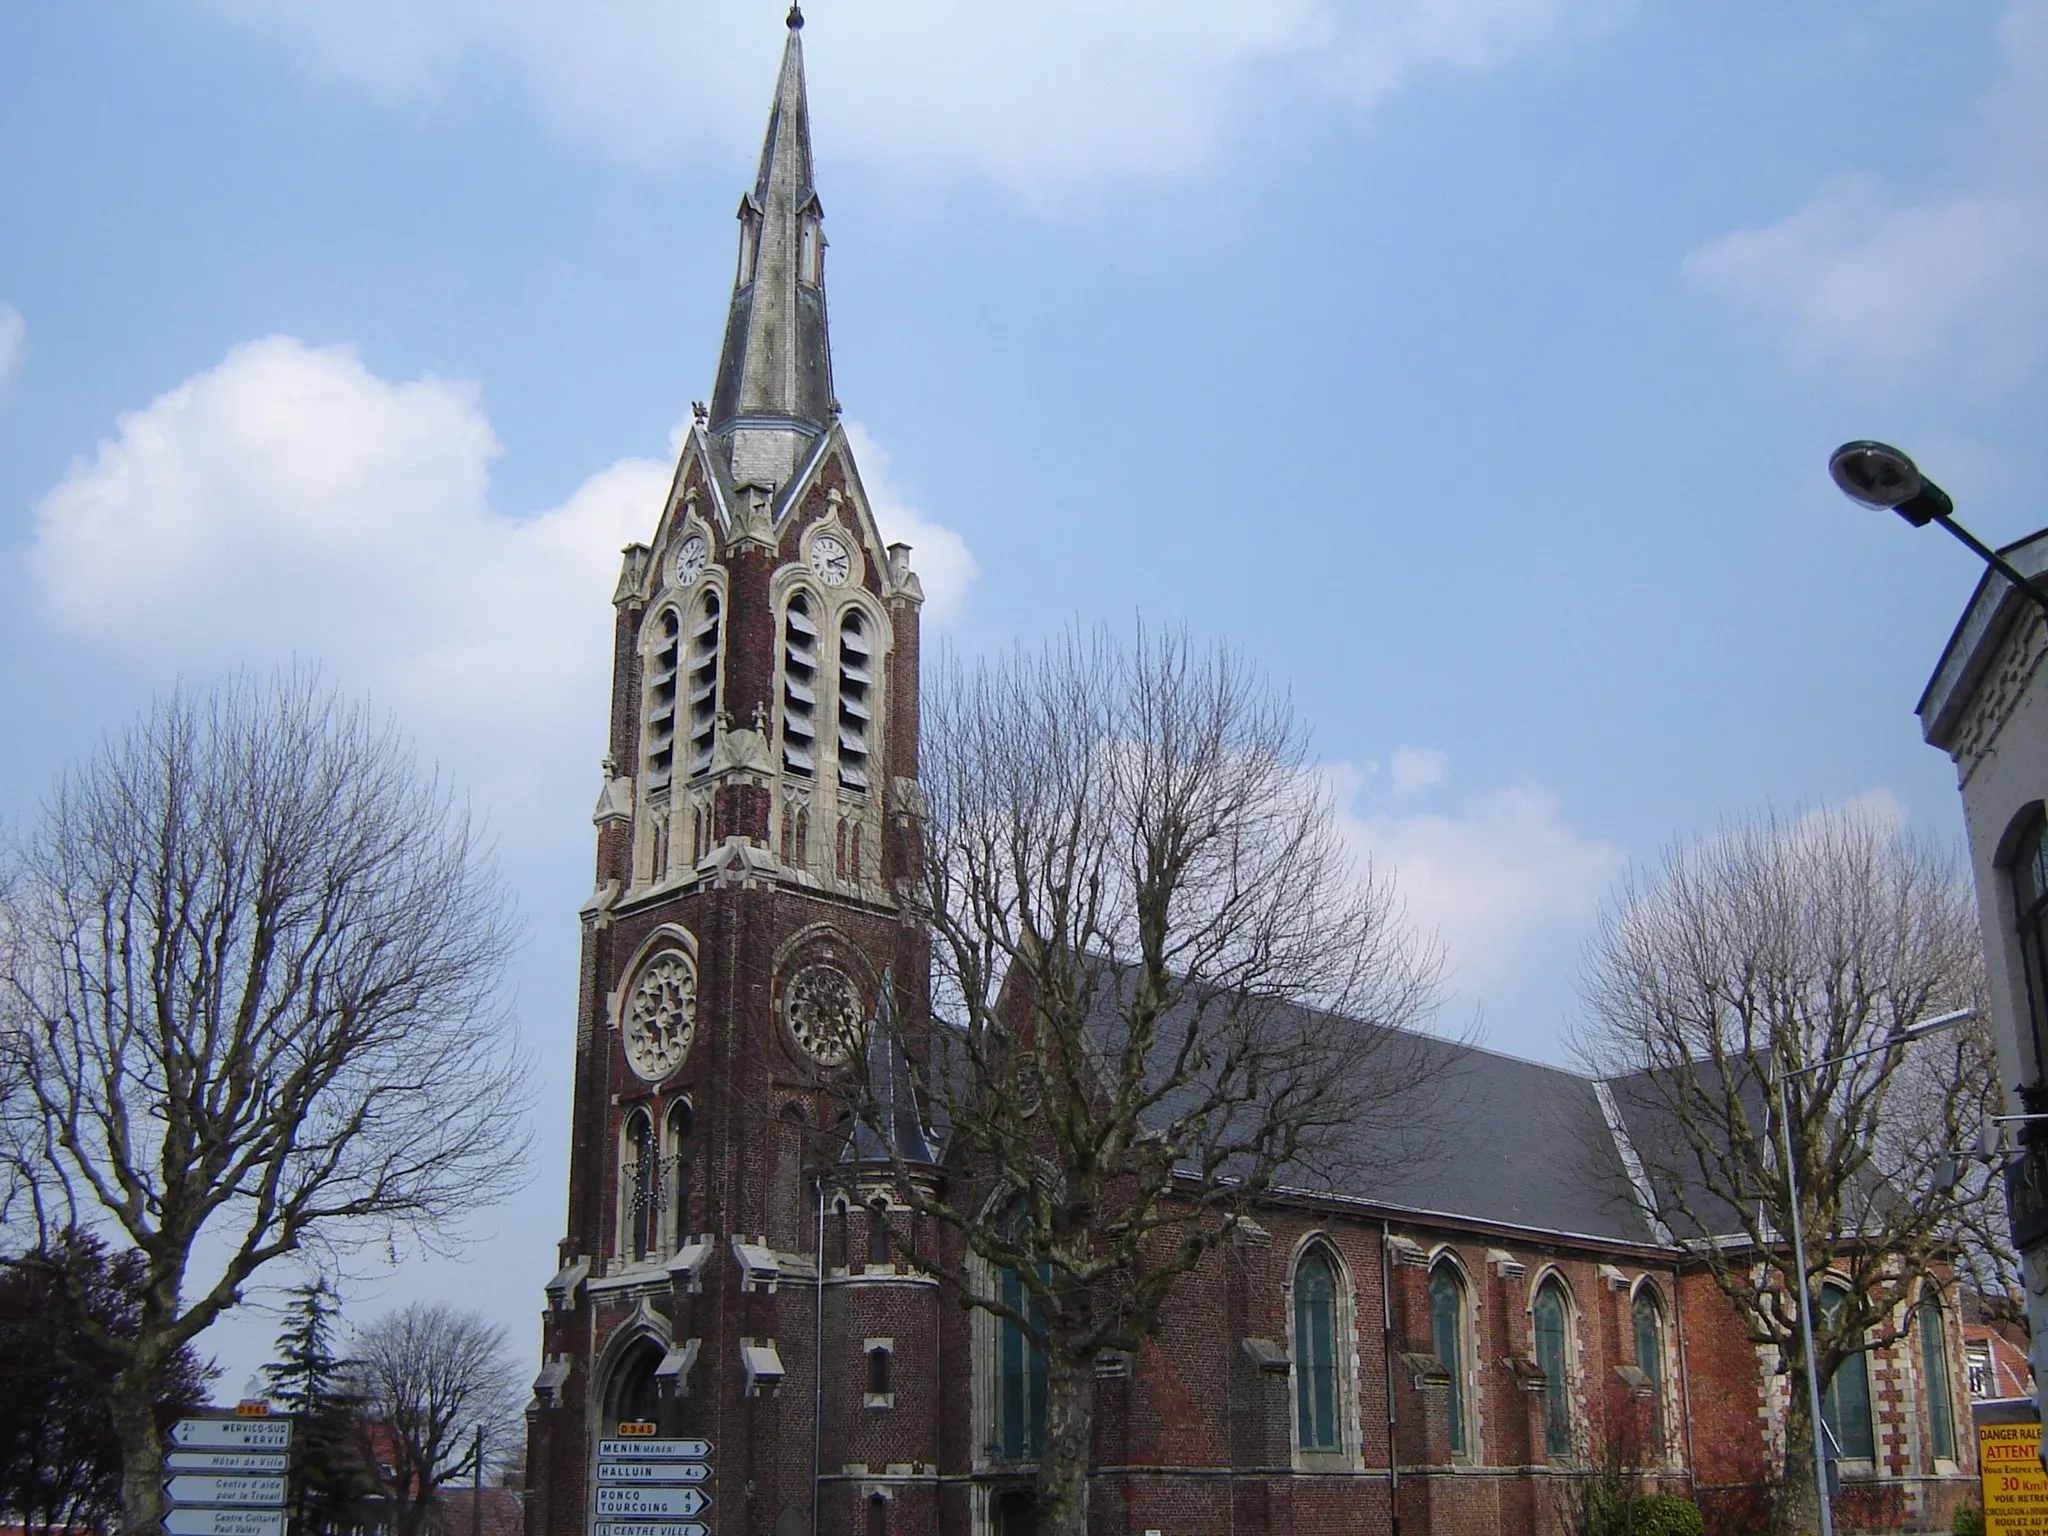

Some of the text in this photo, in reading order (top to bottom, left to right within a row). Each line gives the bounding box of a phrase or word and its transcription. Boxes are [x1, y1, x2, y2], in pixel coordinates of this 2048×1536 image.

[243, 1434, 286, 1444] WERVIK
[1980, 1429, 2018, 1440] DANGER
[603, 1443, 640, 1453] MENIN
[694, 1444, 700, 1453] 5
[211, 1456, 283, 1467] Hôtel de Ville
[601, 1468, 652, 1477] HALLUIN
[1983, 1465, 2002, 1475] Vous
[2004, 1465, 2032, 1474] Entrez
[215, 1479, 281, 1489] Centre d'aide
[2001, 1476, 2019, 1491] 30
[215, 1490, 281, 1501] pour le Travail
[600, 1490, 691, 1500] RONCQ 4
[1994, 1494, 2015, 1504] VOIE
[600, 1503, 691, 1513] TOURCOING 9
[214, 1513, 279, 1523] Centre Culturel
[1995, 1517, 2028, 1527] ROULEZ
[2030, 1517, 2042, 1527] AU
[214, 1524, 232, 1534] Paul
[614, 1526, 690, 1536] CENTRE VILLE
